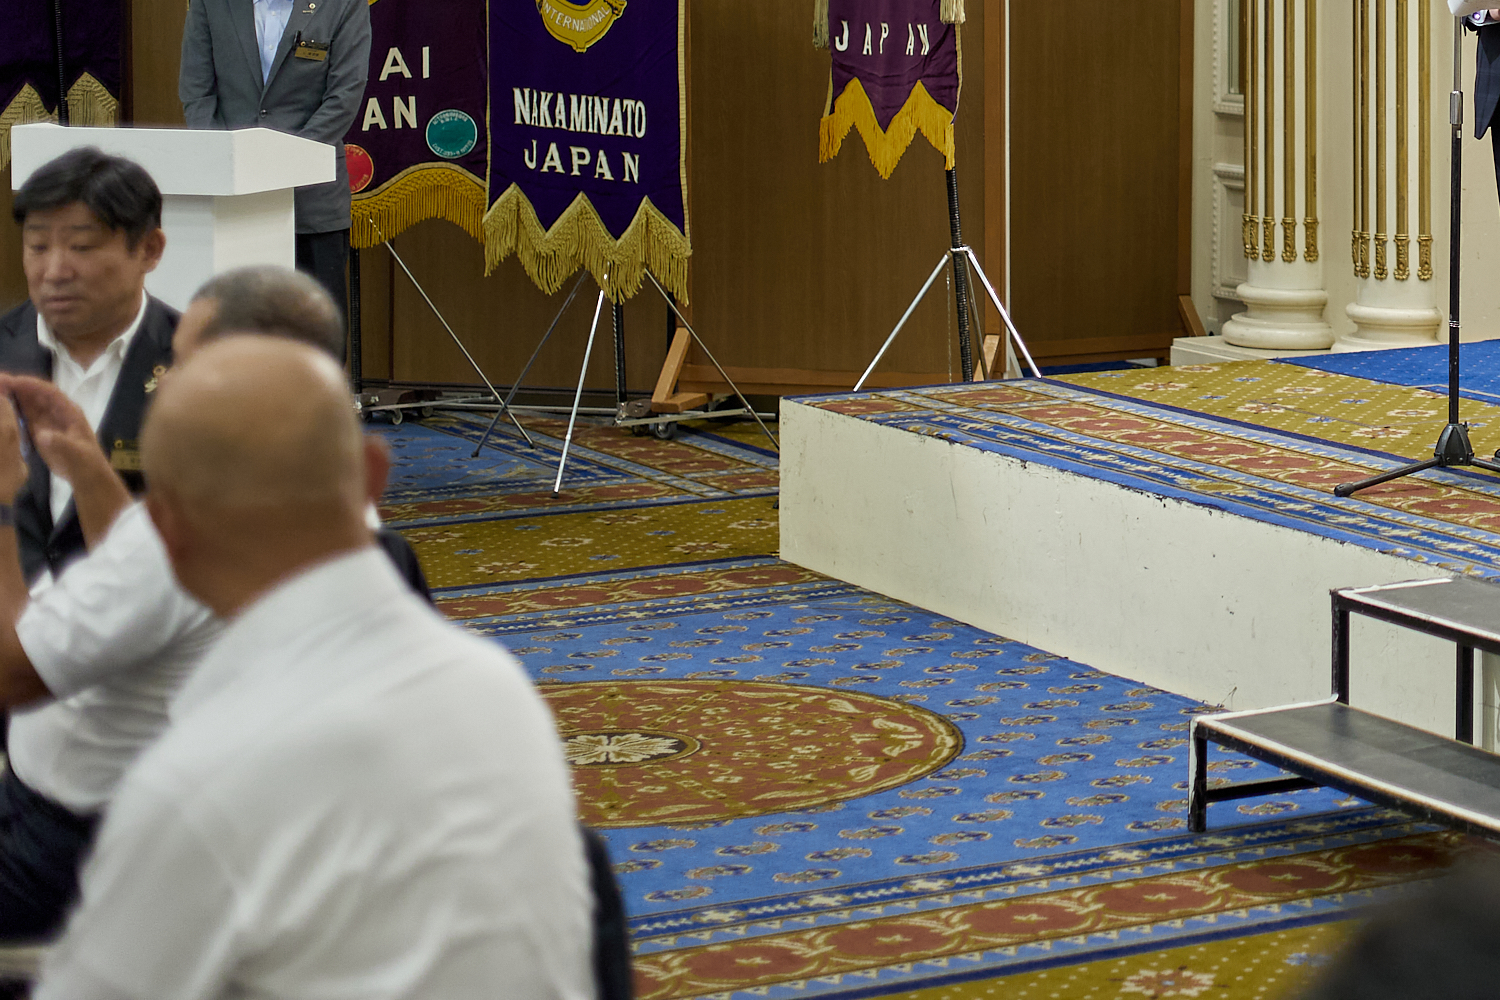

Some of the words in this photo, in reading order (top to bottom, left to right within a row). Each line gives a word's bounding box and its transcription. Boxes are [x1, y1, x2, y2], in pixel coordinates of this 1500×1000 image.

[834, 20, 930, 56] JAPAN
[512, 87, 647, 139] NAKAMINATO
[523, 139, 640, 185] JAPAN
